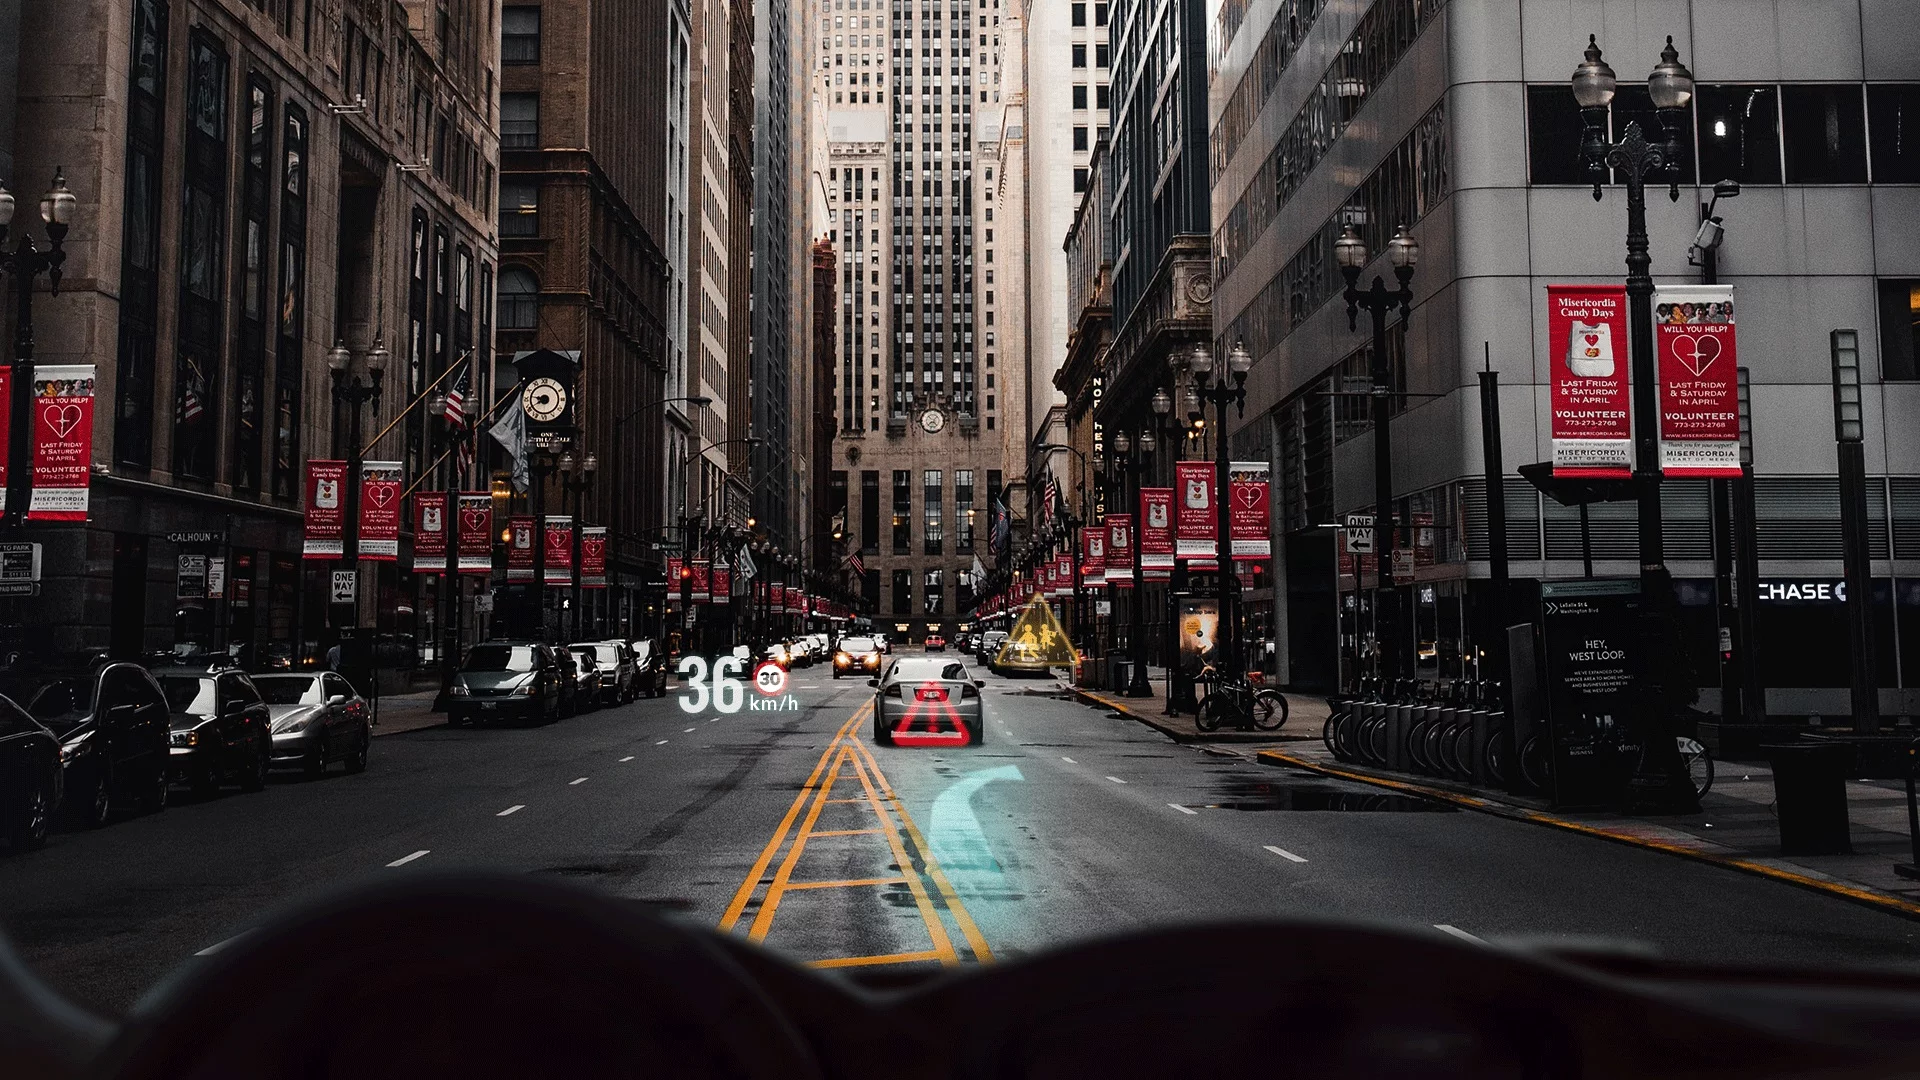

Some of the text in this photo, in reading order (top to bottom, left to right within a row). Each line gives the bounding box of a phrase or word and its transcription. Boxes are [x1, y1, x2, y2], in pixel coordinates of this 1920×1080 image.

[1558, 298, 1616, 307] Misericordia
[1560, 308, 1614, 319] Candy Days
[1704, 325, 1728, 333] HELP?
[1586, 379, 1618, 387] FRIDAY
[1669, 381, 1727, 389] LAST FRIDAY
[1680, 389, 1727, 397] SATURDAY
[1582, 396, 1610, 404] APRIL
[1664, 412, 1735, 420] VOLUNTEER
[171, 532, 211, 542] CALHOUN
[1350, 529, 1372, 538] WAY
[335, 573, 353, 581] ONE
[334, 582, 353, 590] WAY
[1758, 583, 1832, 600] CHASE
[1585, 639, 1608, 650] HEY,
[1568, 650, 1626, 661] WEST LOOP.
